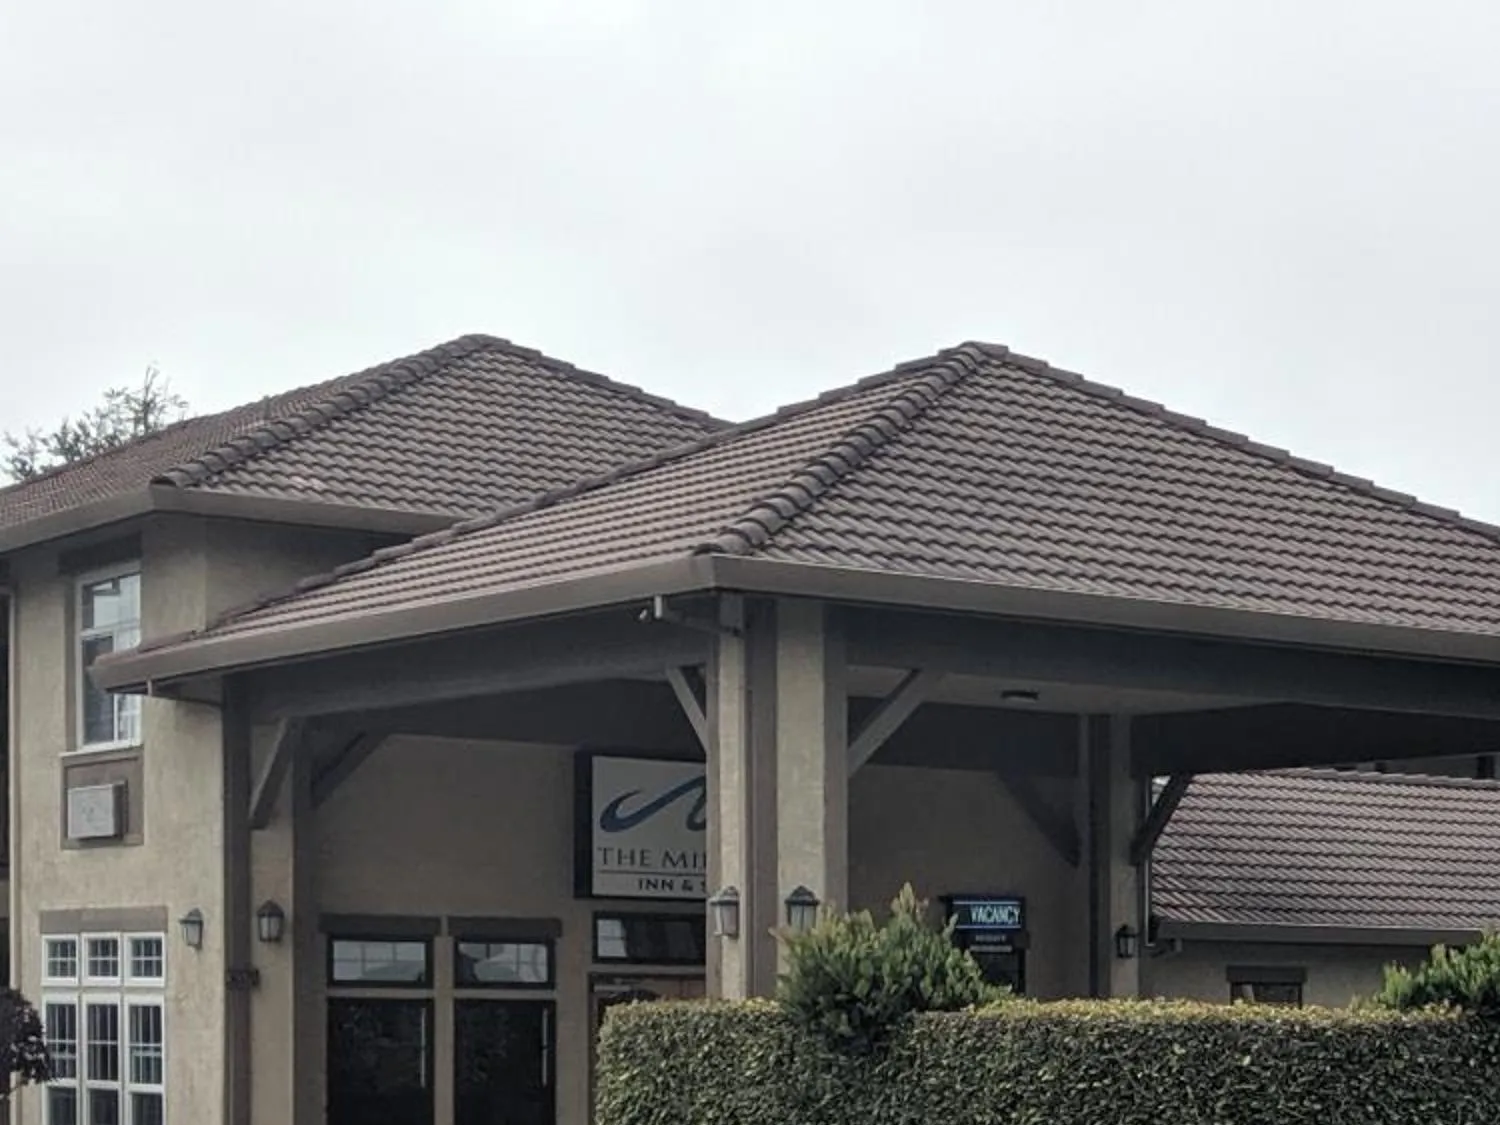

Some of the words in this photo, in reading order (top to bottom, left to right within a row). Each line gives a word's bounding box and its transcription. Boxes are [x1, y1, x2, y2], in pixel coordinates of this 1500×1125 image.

[598, 847, 650, 866] THE
[662, 849, 706, 869] MI
[638, 878, 674, 891] INN
[681, 879, 693, 891] &
[971, 905, 1020, 924] VACANCY
